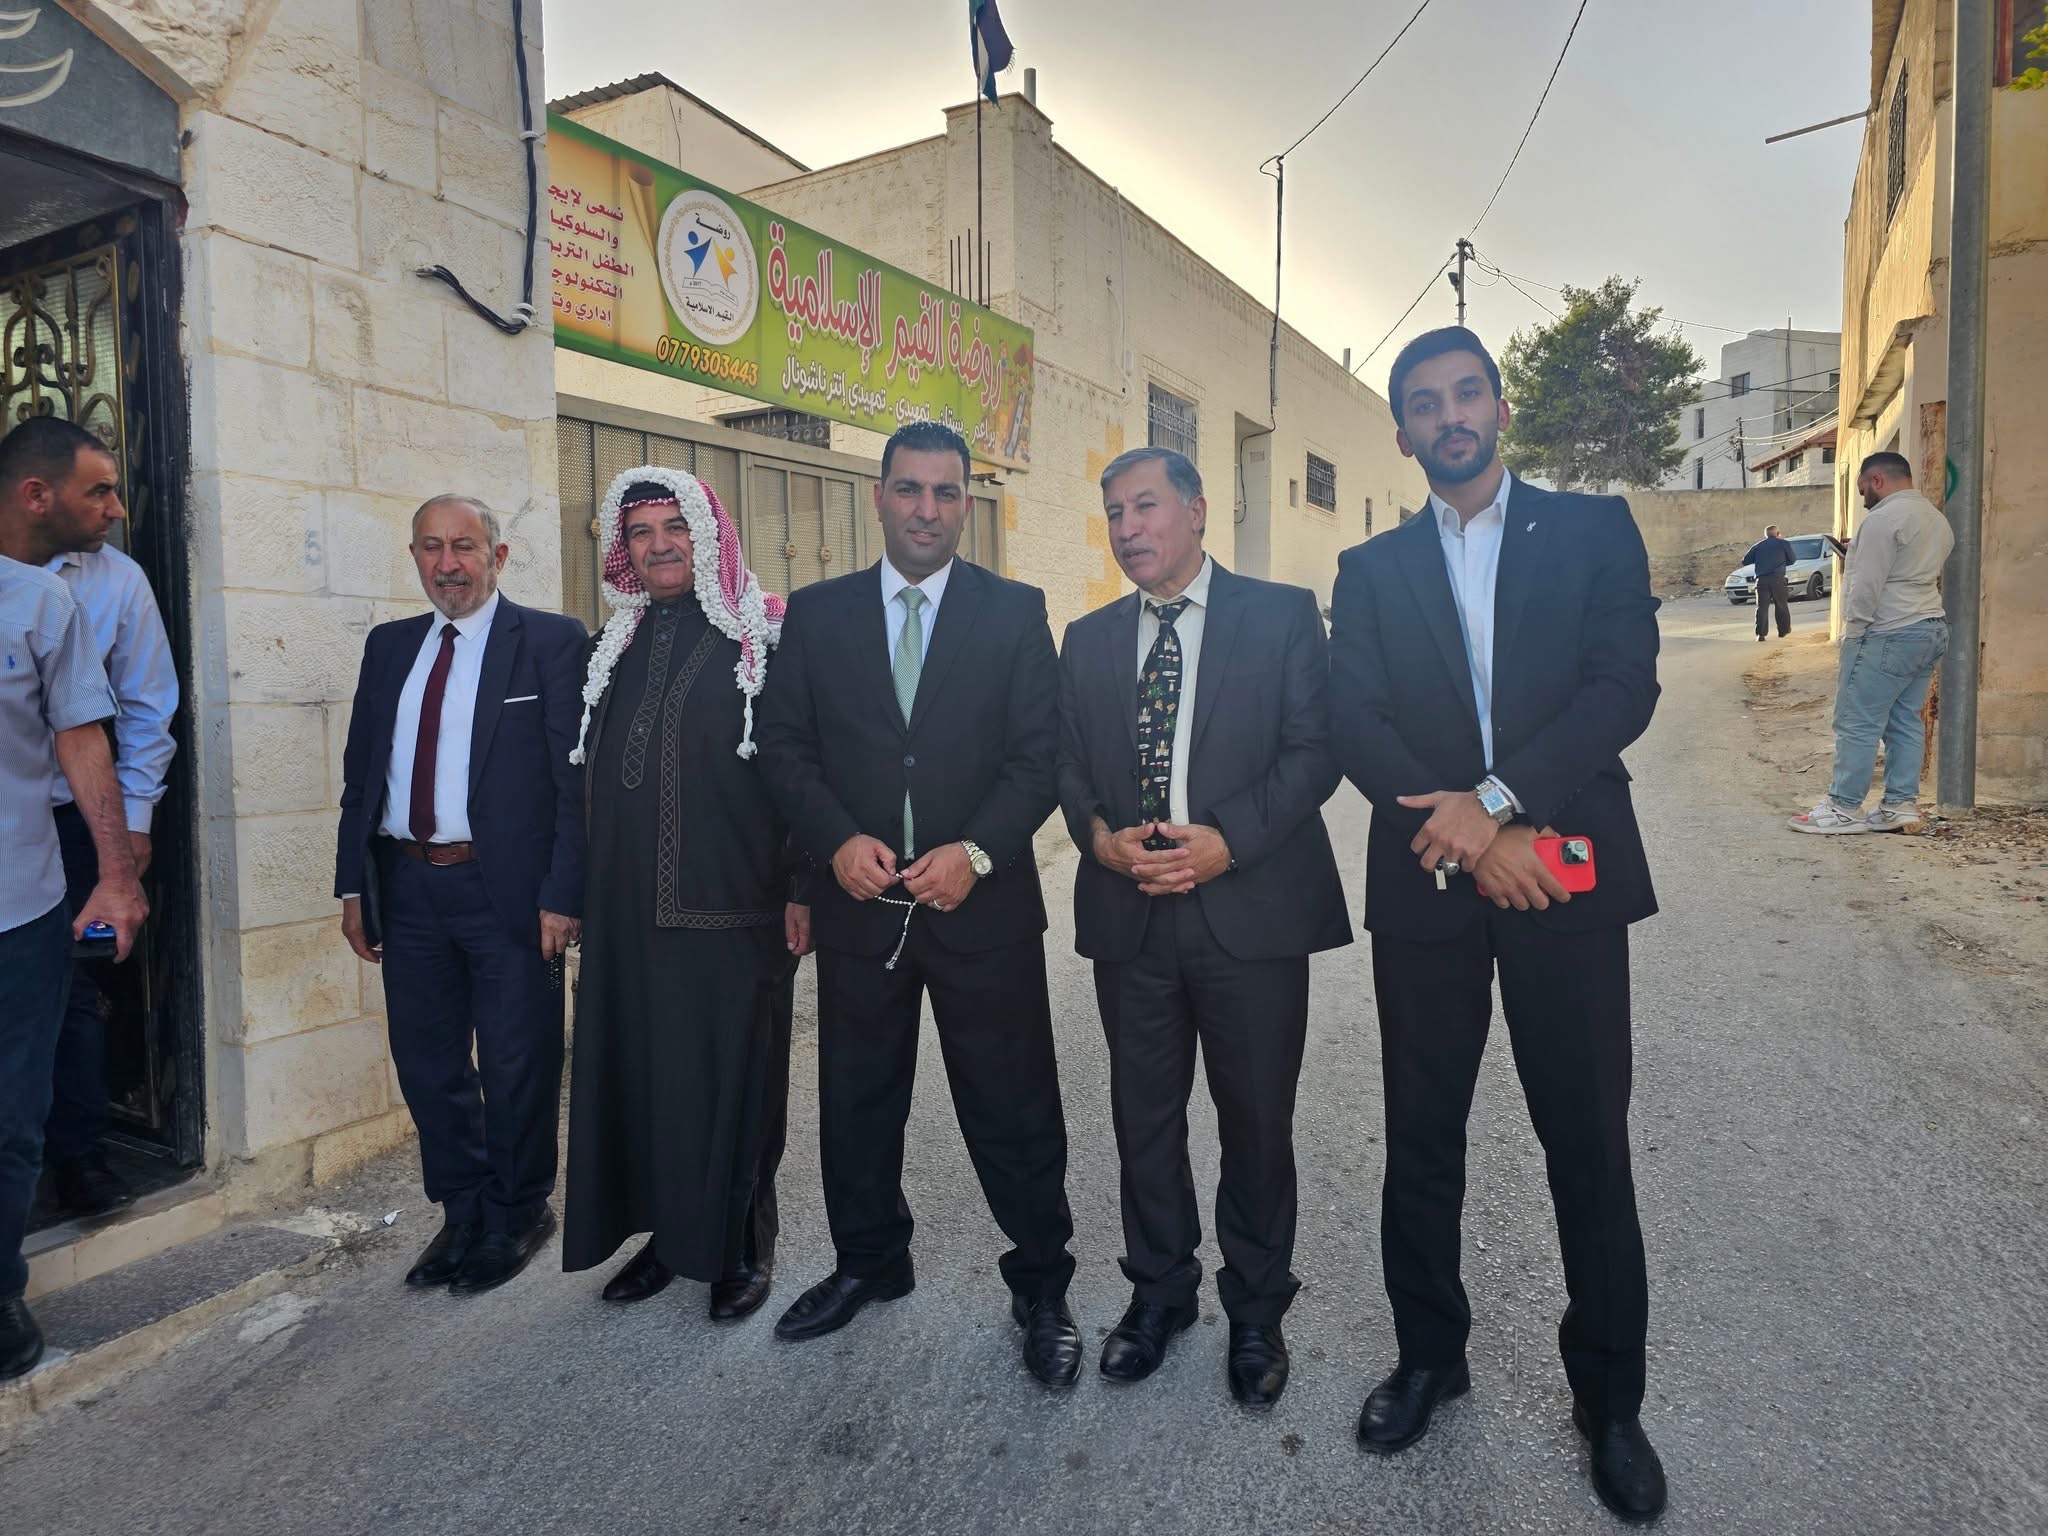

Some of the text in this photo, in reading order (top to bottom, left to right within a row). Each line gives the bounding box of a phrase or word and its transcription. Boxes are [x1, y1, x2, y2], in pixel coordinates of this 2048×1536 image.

[548, 184, 625, 222] نسعى لإيج
[550, 208, 619, 249] والسلوكيا
[552, 267, 623, 299] التكنولوج
[592, 253, 634, 278] الطفل
[576, 303, 612, 327] إداري
[768, 221, 1002, 409] روضة القيم الإسلامية
[657, 335, 759, 387] 0779303443
[848, 383, 886, 416] تمهيدي
